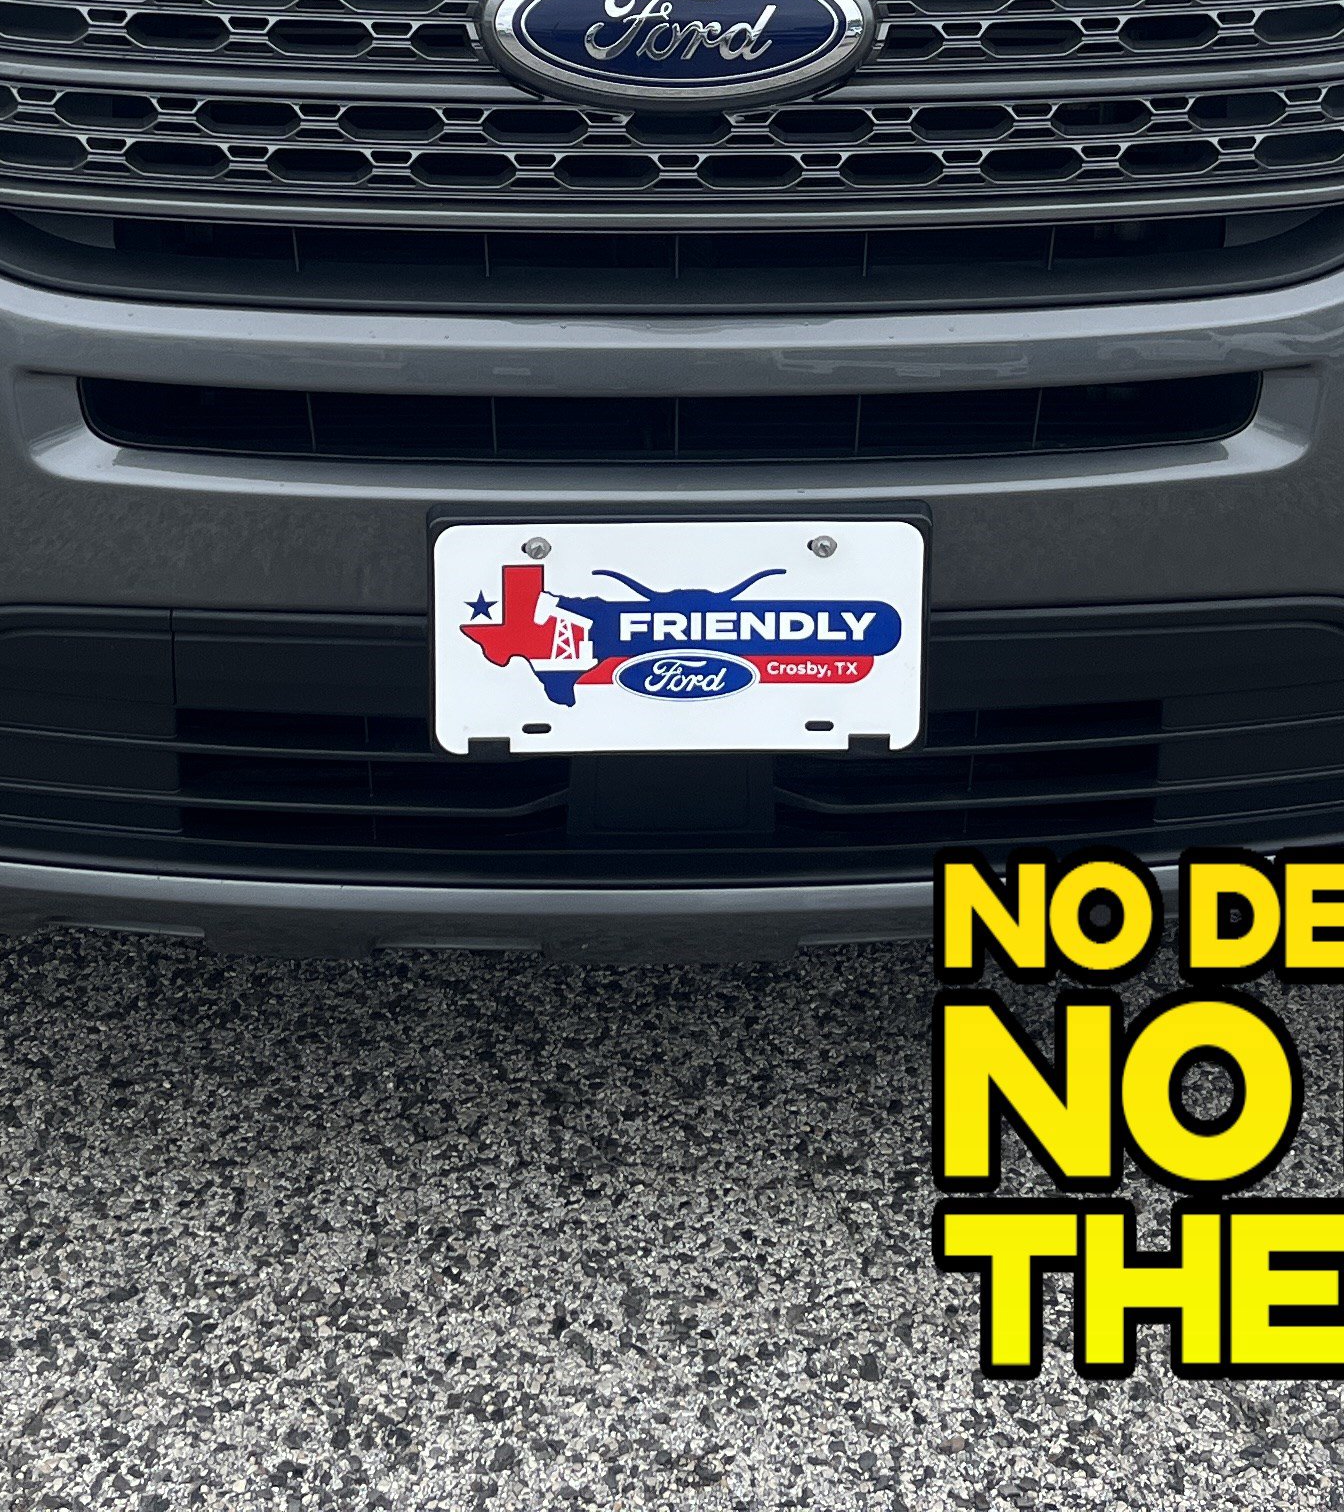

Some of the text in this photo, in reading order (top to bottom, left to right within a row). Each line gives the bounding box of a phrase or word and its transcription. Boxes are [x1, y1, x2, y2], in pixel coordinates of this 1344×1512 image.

[619, 611, 877, 642] FRIENDLY
[644, 659, 727, 693] Ford
[767, 660, 858, 678] Crosby, TX
